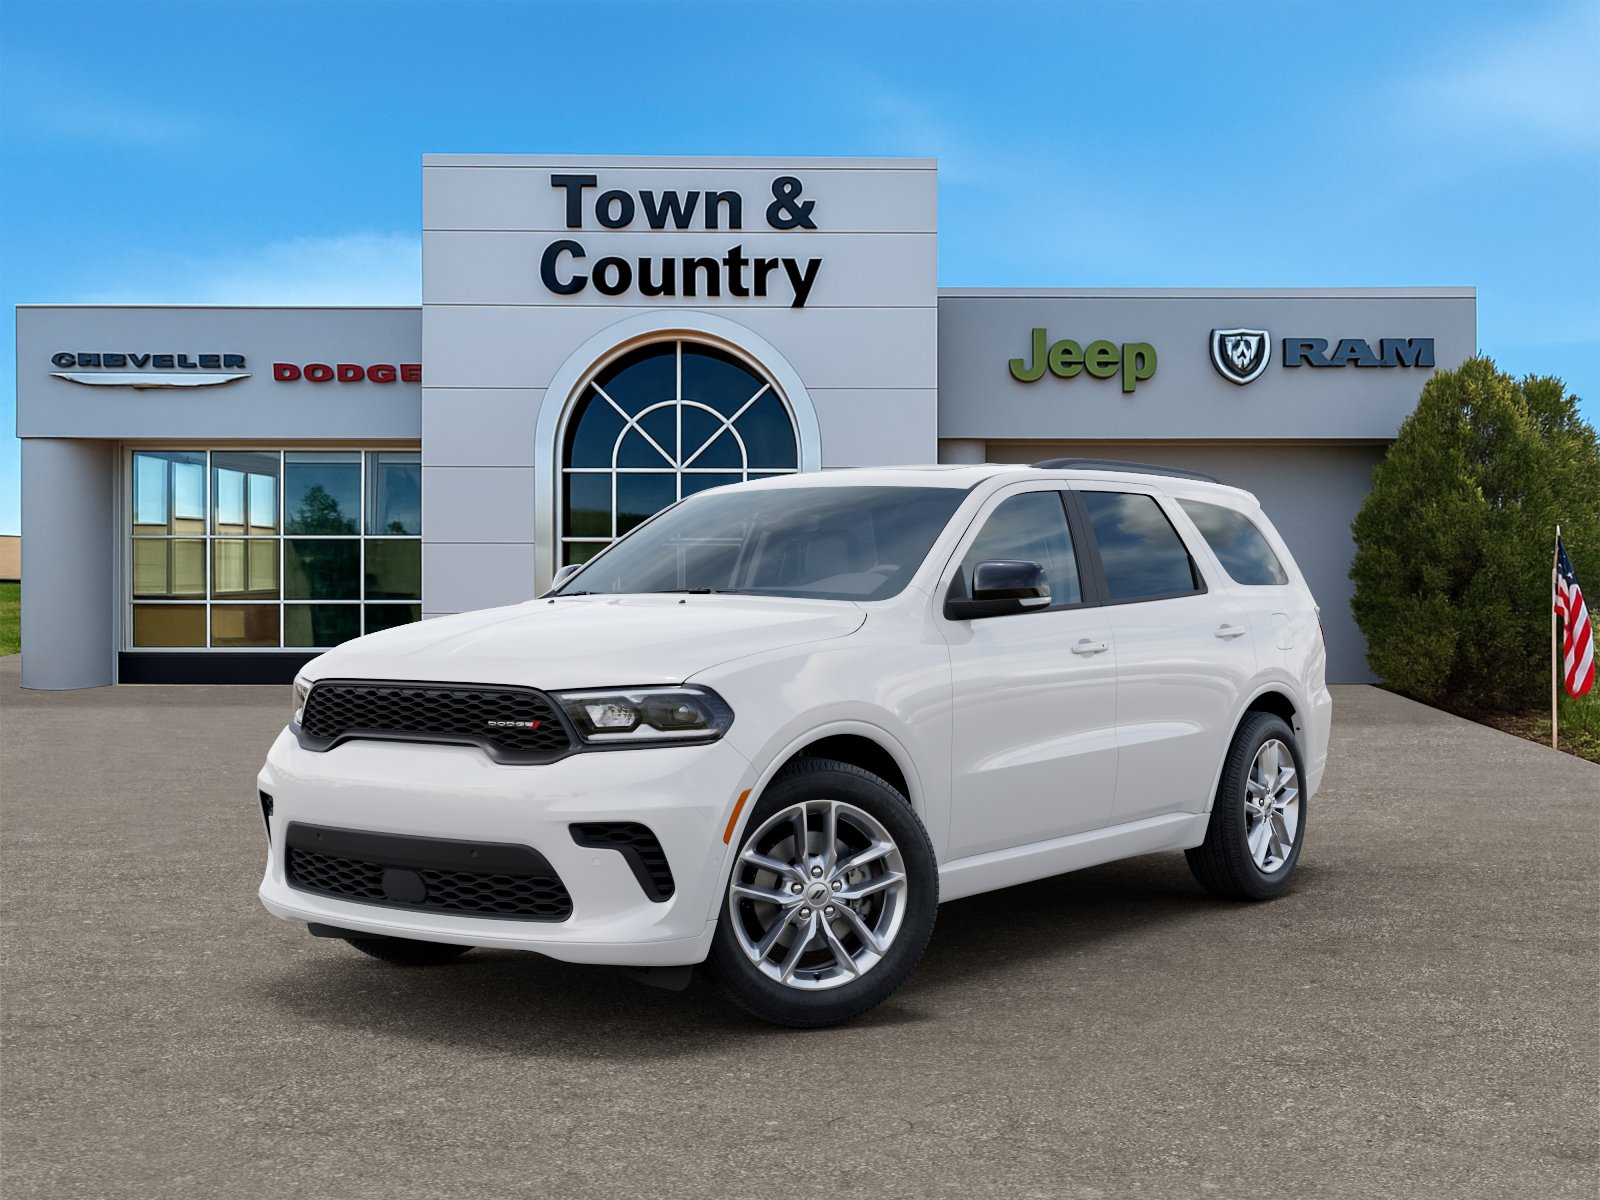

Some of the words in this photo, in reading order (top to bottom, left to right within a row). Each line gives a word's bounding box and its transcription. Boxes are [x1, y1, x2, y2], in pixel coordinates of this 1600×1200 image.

[550, 174, 742, 229] Town
[766, 176, 818, 230] &
[540, 239, 822, 308] Country
[273, 363, 422, 383] DODGE
[1008, 327, 1157, 393] Jeep
[1282, 337, 1435, 367] RAM
